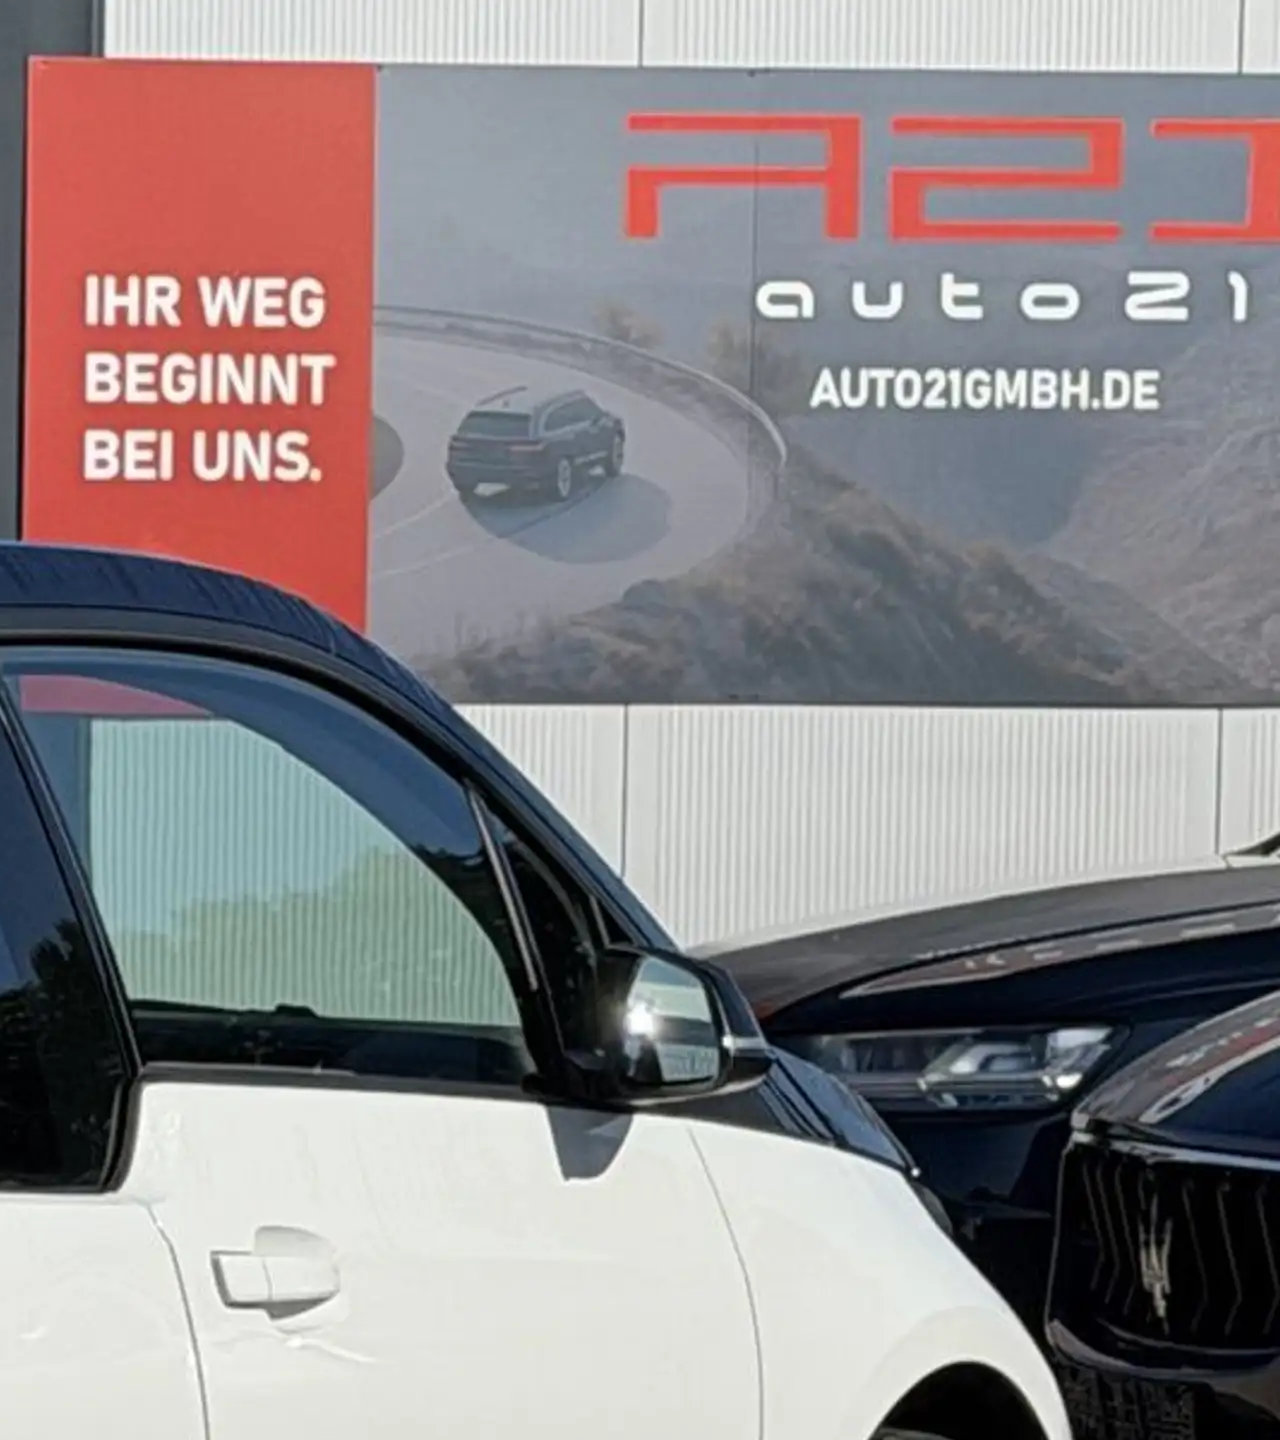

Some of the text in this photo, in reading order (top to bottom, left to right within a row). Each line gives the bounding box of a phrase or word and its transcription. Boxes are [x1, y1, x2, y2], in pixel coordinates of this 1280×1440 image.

[84, 274, 326, 329] IHR WEG
[84, 351, 338, 406] BEGINNT
[809, 366, 1162, 412] AUTO21GMBH.DE
[83, 428, 322, 482] BEI UNS.
